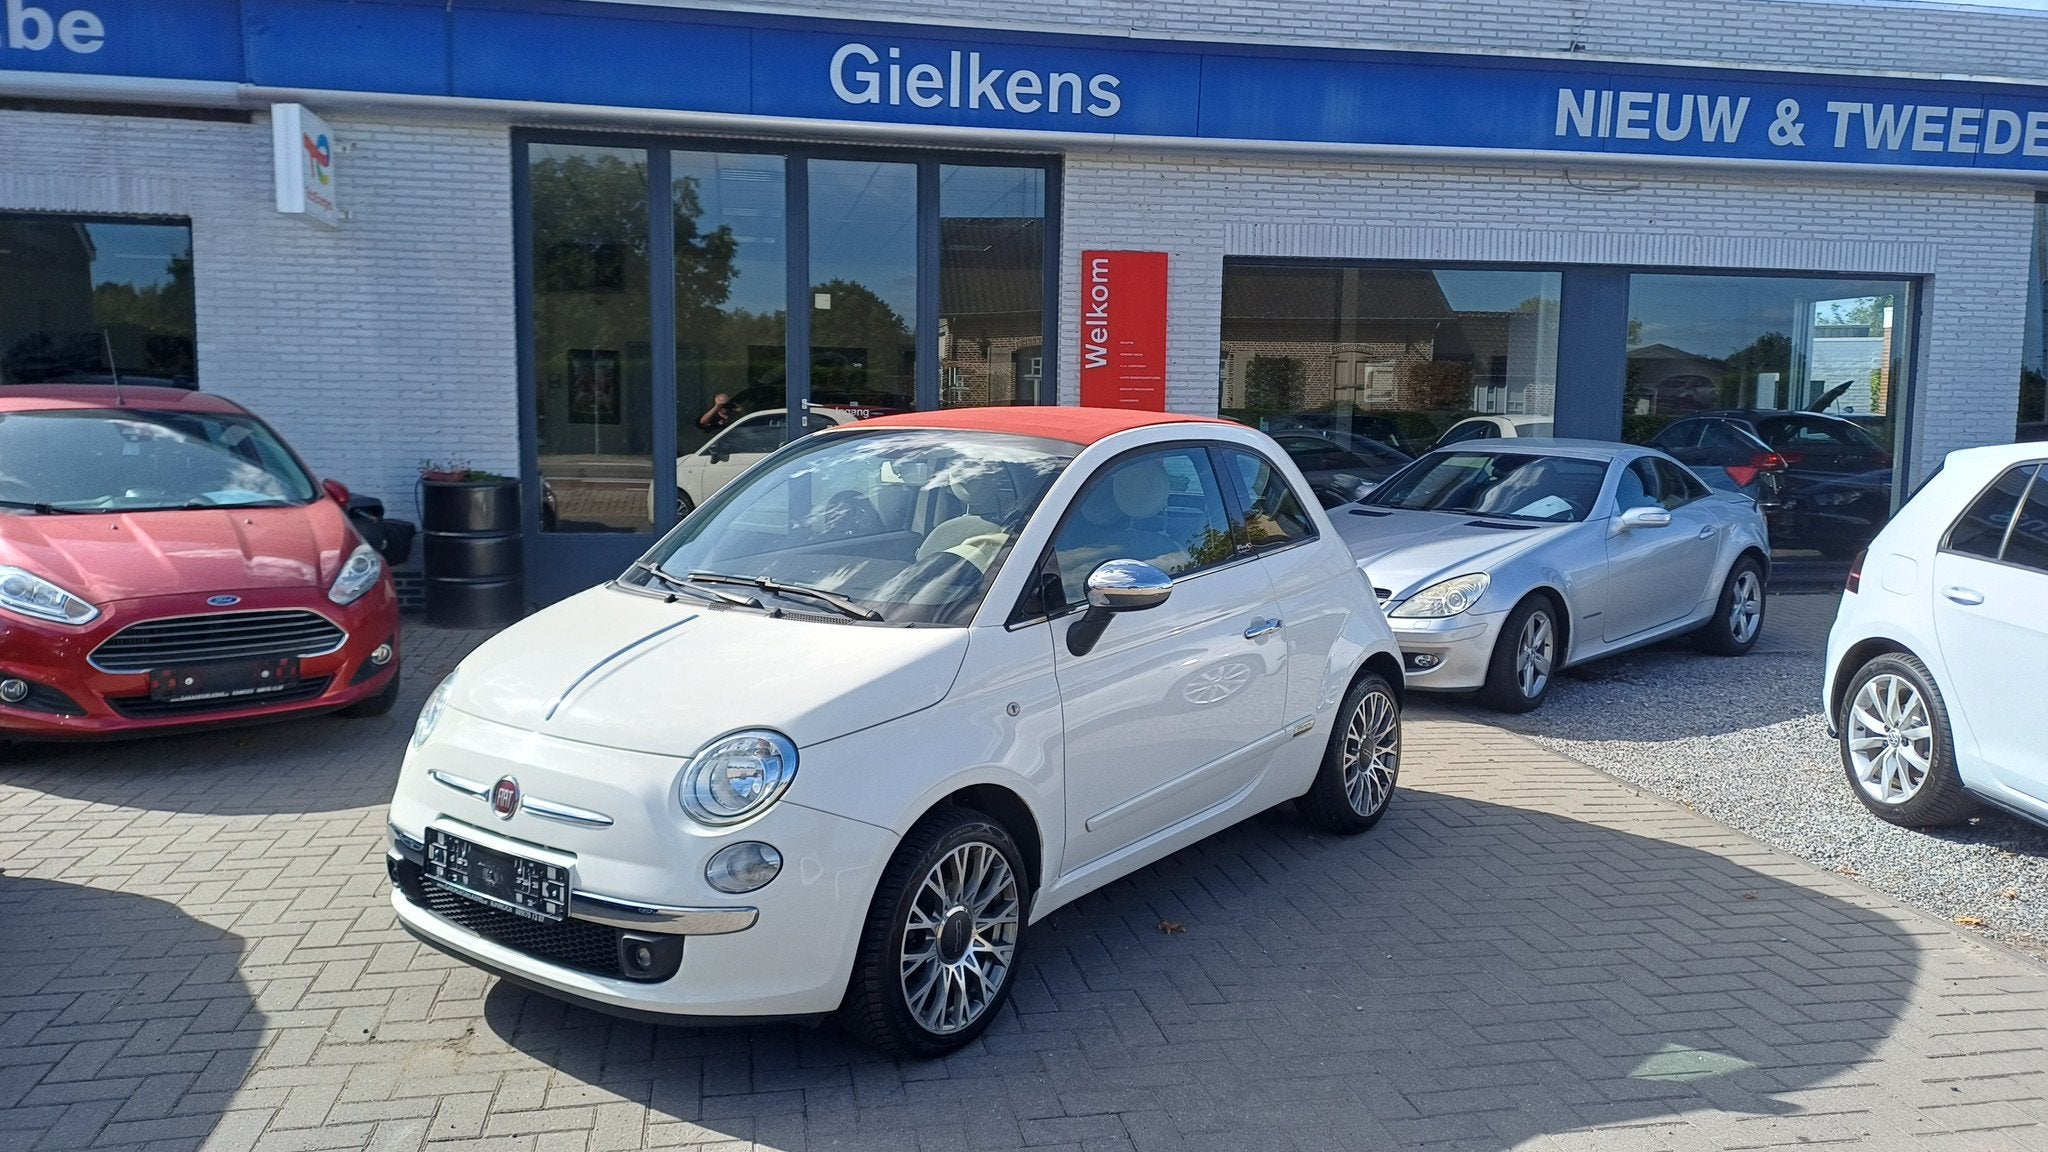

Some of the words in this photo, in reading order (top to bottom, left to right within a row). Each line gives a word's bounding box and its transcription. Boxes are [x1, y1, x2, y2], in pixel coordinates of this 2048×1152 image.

[0, 0, 105, 54] be
[830, 43, 1122, 117] Gielkens
[1554, 88, 1751, 143] NIEUW
[1768, 98, 1805, 146] &
[1826, 101, 2048, 157] TWEEDE
[1085, 258, 1109, 369] Welkom
[496, 787, 514, 809] FIAT
